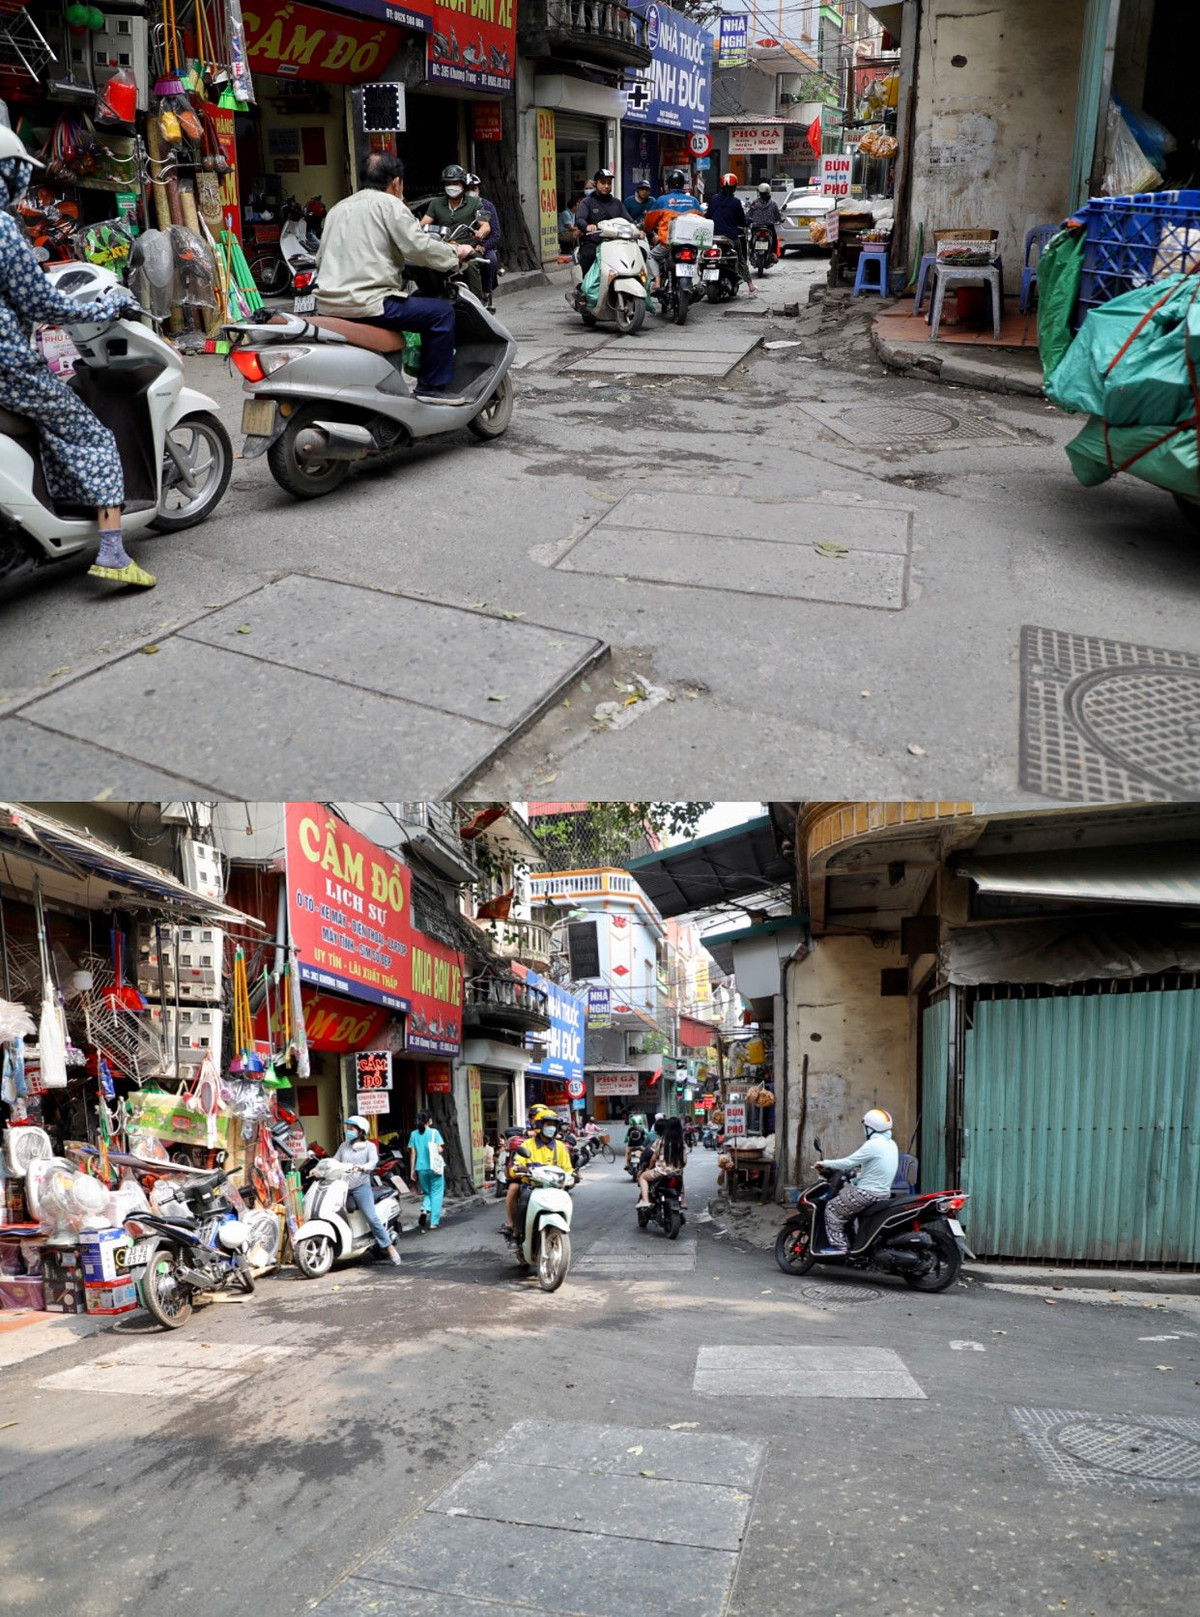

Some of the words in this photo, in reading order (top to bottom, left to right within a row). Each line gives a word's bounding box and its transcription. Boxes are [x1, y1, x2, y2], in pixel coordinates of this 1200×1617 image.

[723, 17, 745, 31] NHÀ
[660, 22, 678, 55] NHÀ
[680, 31, 705, 65] THUỐC
[721, 31, 746, 48] NGHỈ
[678, 65, 706, 113] ĐỨC
[539, 114, 553, 146] ĐẠI
[732, 127, 758, 138] PHỞ
[761, 127, 780, 138] GÀ
[542, 150, 552, 181] LÝ
[825, 158, 849, 171] BÚN
[824, 182, 849, 194] PHỞ
[541, 188, 556, 218] GẠO
[299, 817, 365, 891] CẦM
[371, 864, 404, 912] ĐỒ
[320, 903, 331, 920] XE
[325, 877, 363, 915] LỊCH
[368, 900, 388, 928] SỰ
[314, 947, 325, 963] UY
[328, 952, 342, 970] TÍN
[412, 946, 431, 996] MUA
[451, 965, 461, 1006] XE
[590, 990, 608, 1001] NHÀ
[562, 1029, 581, 1064] ĐỨC
[727, 1107, 744, 1117] BÚN
